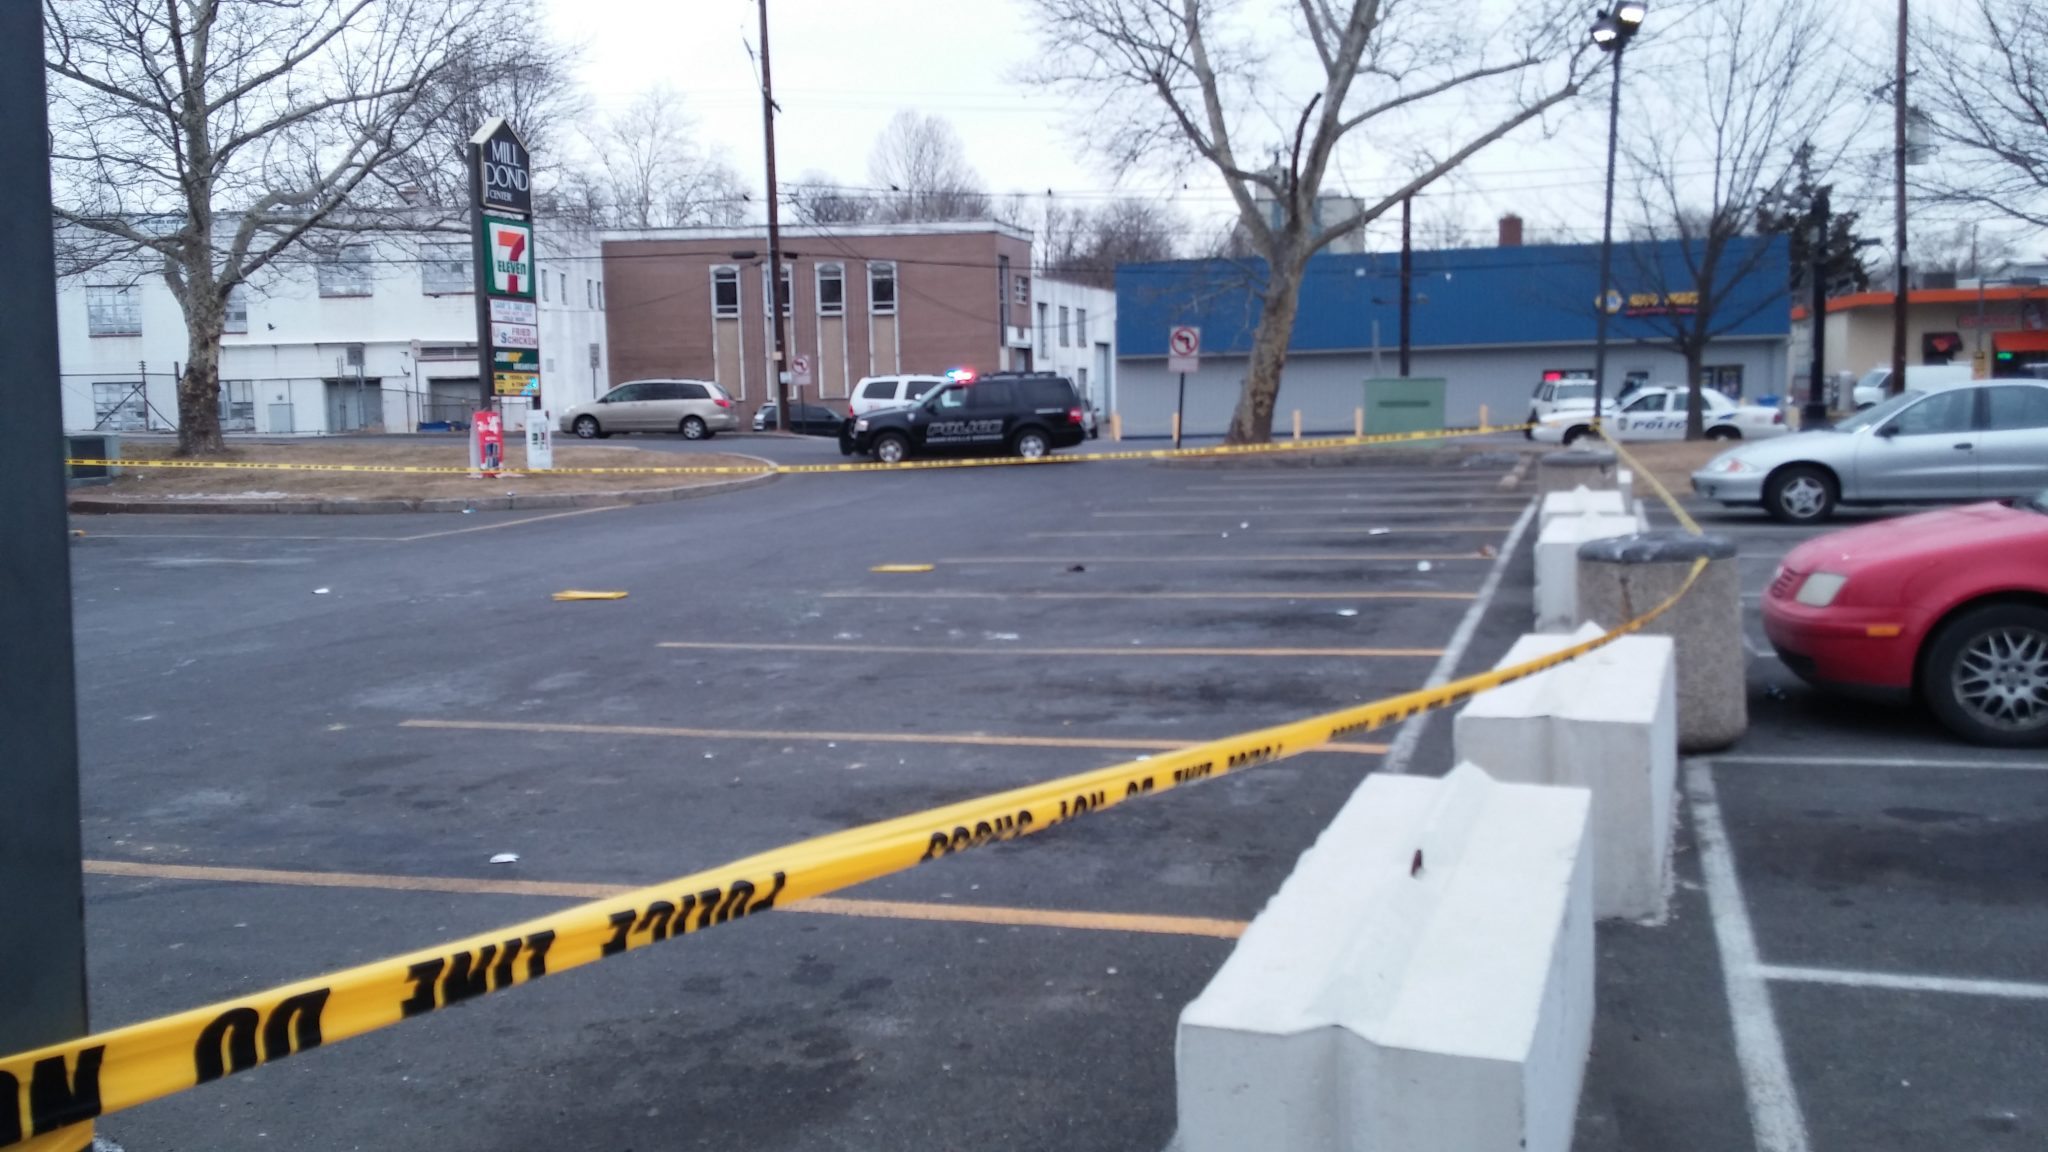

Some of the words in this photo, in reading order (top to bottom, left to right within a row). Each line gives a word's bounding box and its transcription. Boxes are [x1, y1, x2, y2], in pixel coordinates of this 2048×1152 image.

[491, 139, 520, 167] MILL
[484, 162, 529, 197] POND
[489, 190, 512, 202] CENTER
[497, 231, 525, 293] 7
[1632, 420, 1688, 430] POLIC
